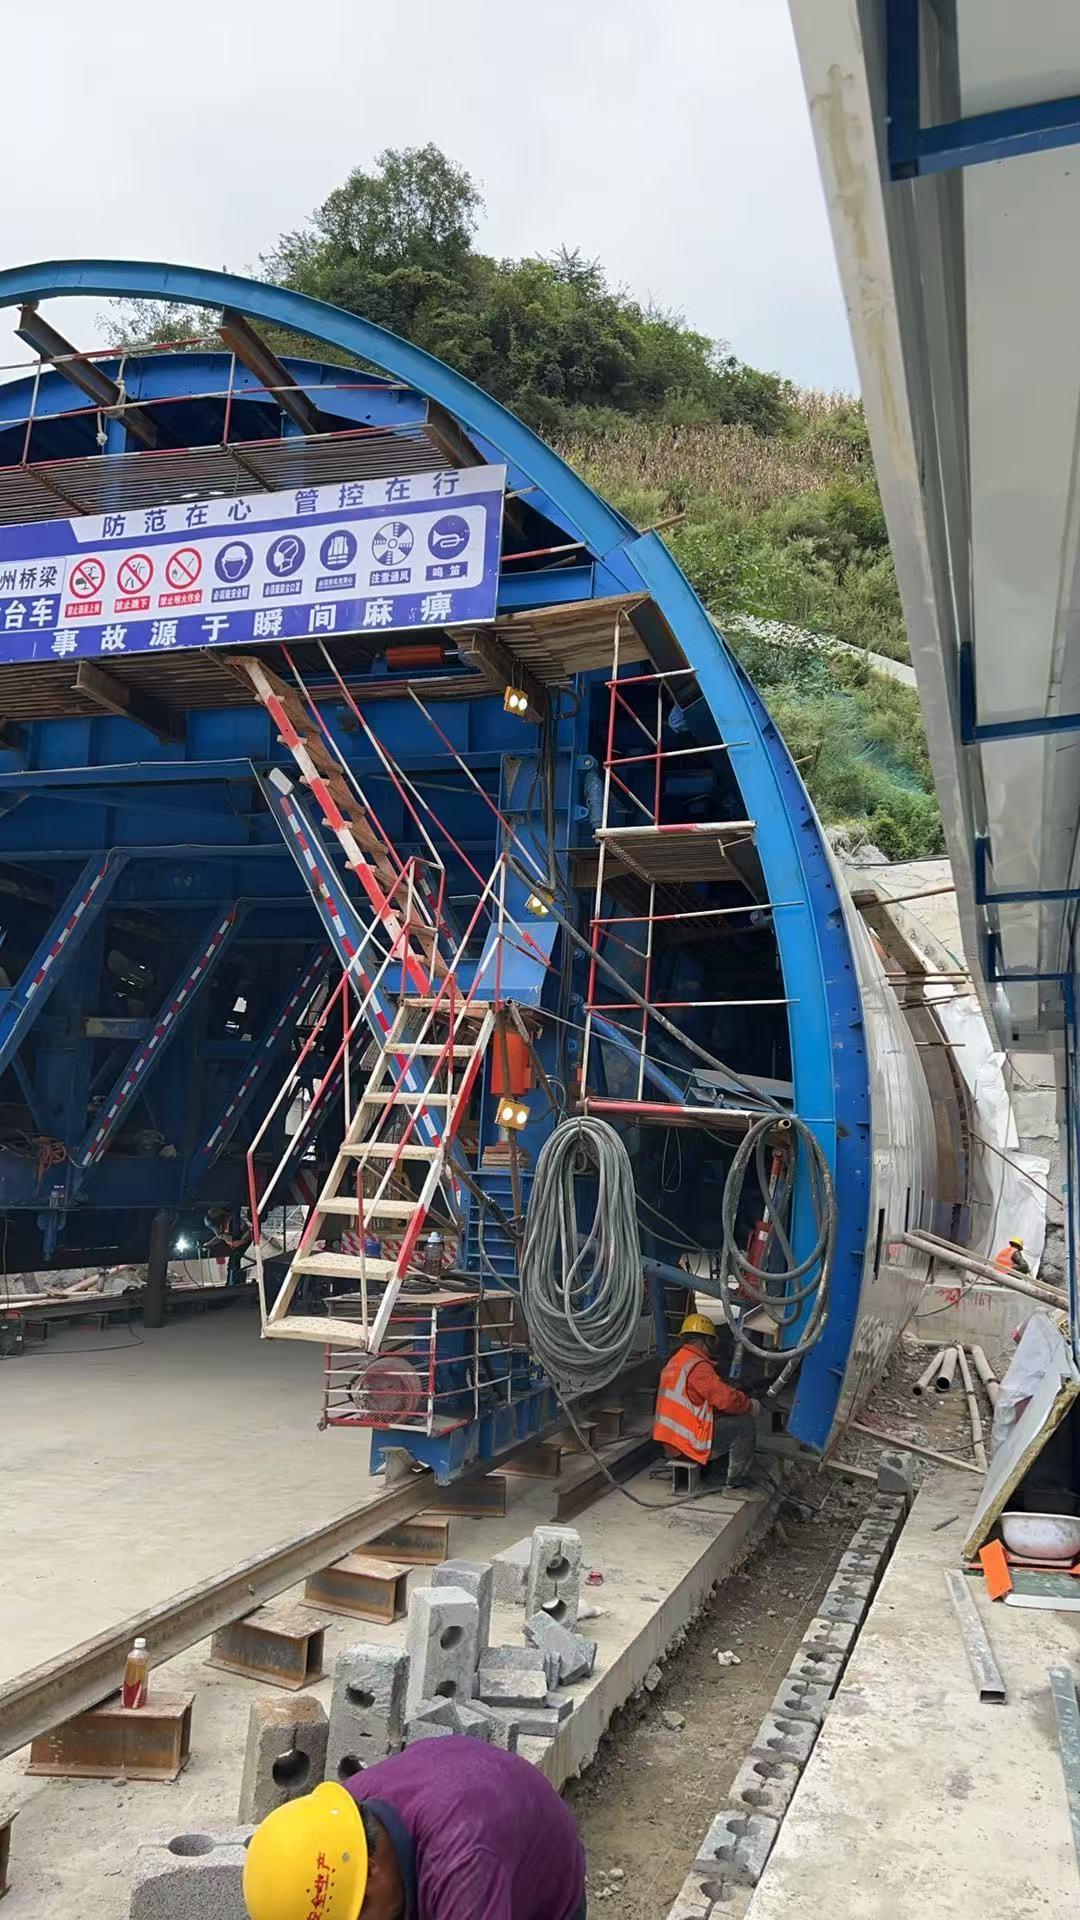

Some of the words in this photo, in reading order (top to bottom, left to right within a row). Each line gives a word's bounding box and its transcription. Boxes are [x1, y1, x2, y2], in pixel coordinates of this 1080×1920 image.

[102, 499, 252, 538] 防范在心
[294, 471, 460, 514] 管控在行
[0, 566, 57, 591] 州桥梁
[370, 569, 410, 585] 注意通风
[432, 565, 462, 578] 鸣笛
[0, 598, 54, 629] 台车
[51, 592, 453, 658] 事故源于瞬间麻痹
